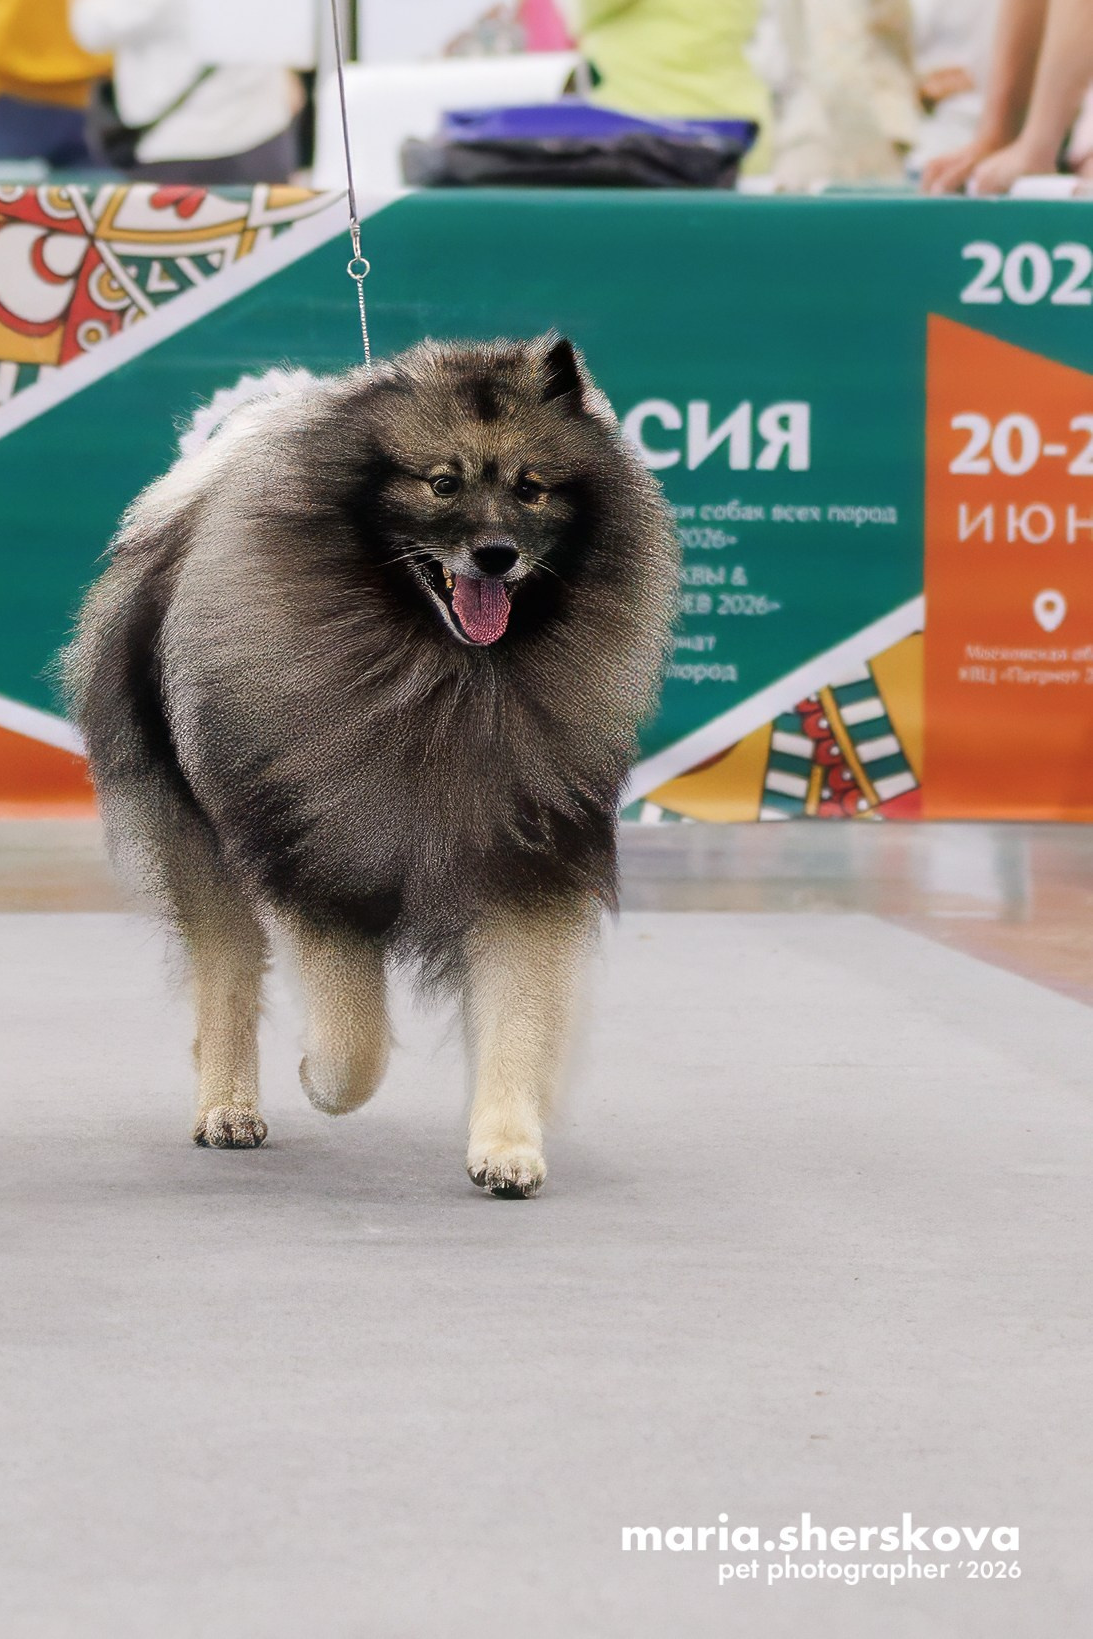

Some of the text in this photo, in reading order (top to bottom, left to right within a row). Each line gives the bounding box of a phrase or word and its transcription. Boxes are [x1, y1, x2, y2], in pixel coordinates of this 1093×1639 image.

[960, 241, 1093, 306] 202
[621, 397, 811, 472] СИЯ
[948, 413, 1093, 476] 20-2
[699, 498, 765, 522] собак
[770, 503, 822, 523] всех
[827, 505, 899, 528] пород
[957, 503, 1093, 544] ИЮН
